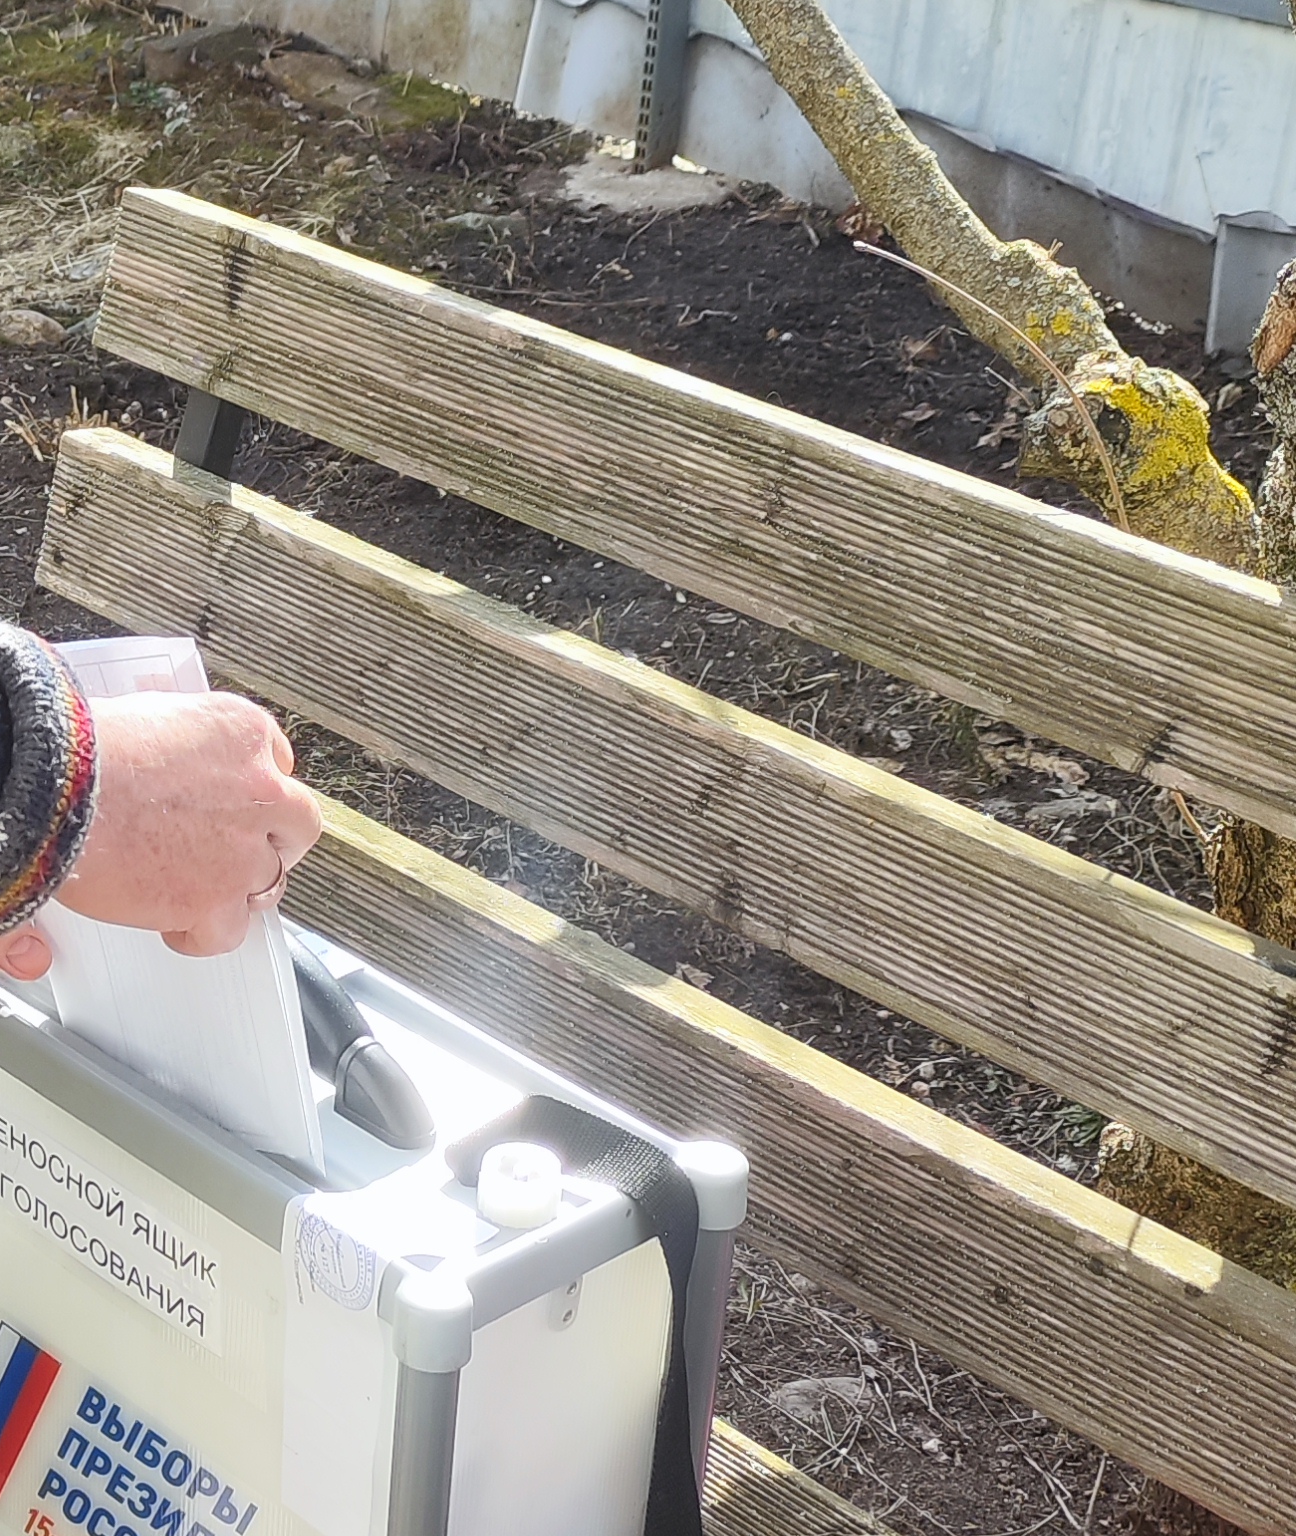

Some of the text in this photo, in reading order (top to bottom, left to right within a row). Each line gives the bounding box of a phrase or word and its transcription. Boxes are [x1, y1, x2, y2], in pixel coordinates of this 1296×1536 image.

[1, 1173, 205, 1337] ГОЛОСОВАНИЯ
[132, 1213, 216, 1288] ЯЩИК
[76, 1386, 258, 1536] ВЫБОРЫ
